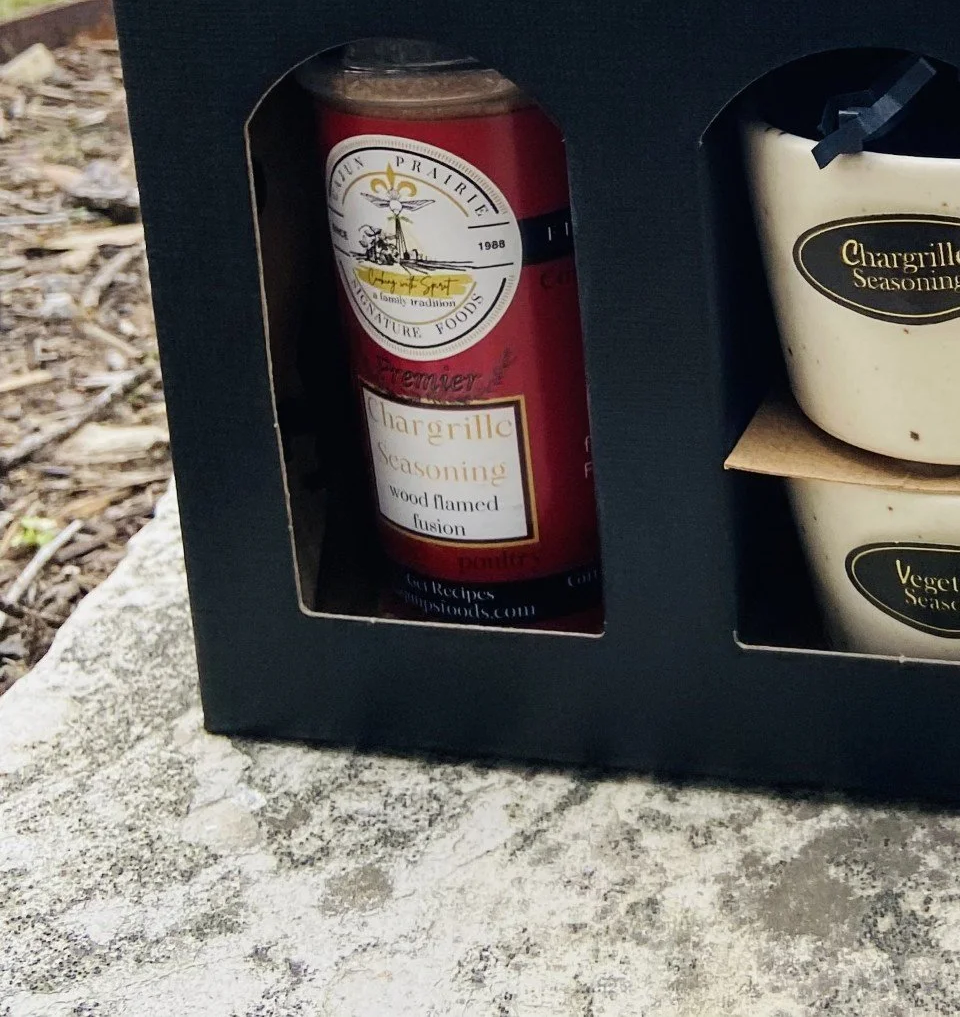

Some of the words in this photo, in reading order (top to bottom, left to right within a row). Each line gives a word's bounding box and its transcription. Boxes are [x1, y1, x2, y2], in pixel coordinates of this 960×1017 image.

[396, 155, 490, 217] PRAIRIE
[478, 239, 506, 251] 1988
[350, 277, 422, 339] SIGNATURE
[435, 292, 484, 335] FOODS
[379, 293, 407, 308] family
[409, 296, 456, 308] tradition
[376, 355, 479, 392] Premier
[367, 396, 513, 447] Chargrille
[377, 441, 508, 487] Seasoning
[389, 484, 429, 508] wood
[433, 494, 499, 513] flamed
[413, 513, 467, 537] fusion
[432, 581, 495, 604] Recipes
